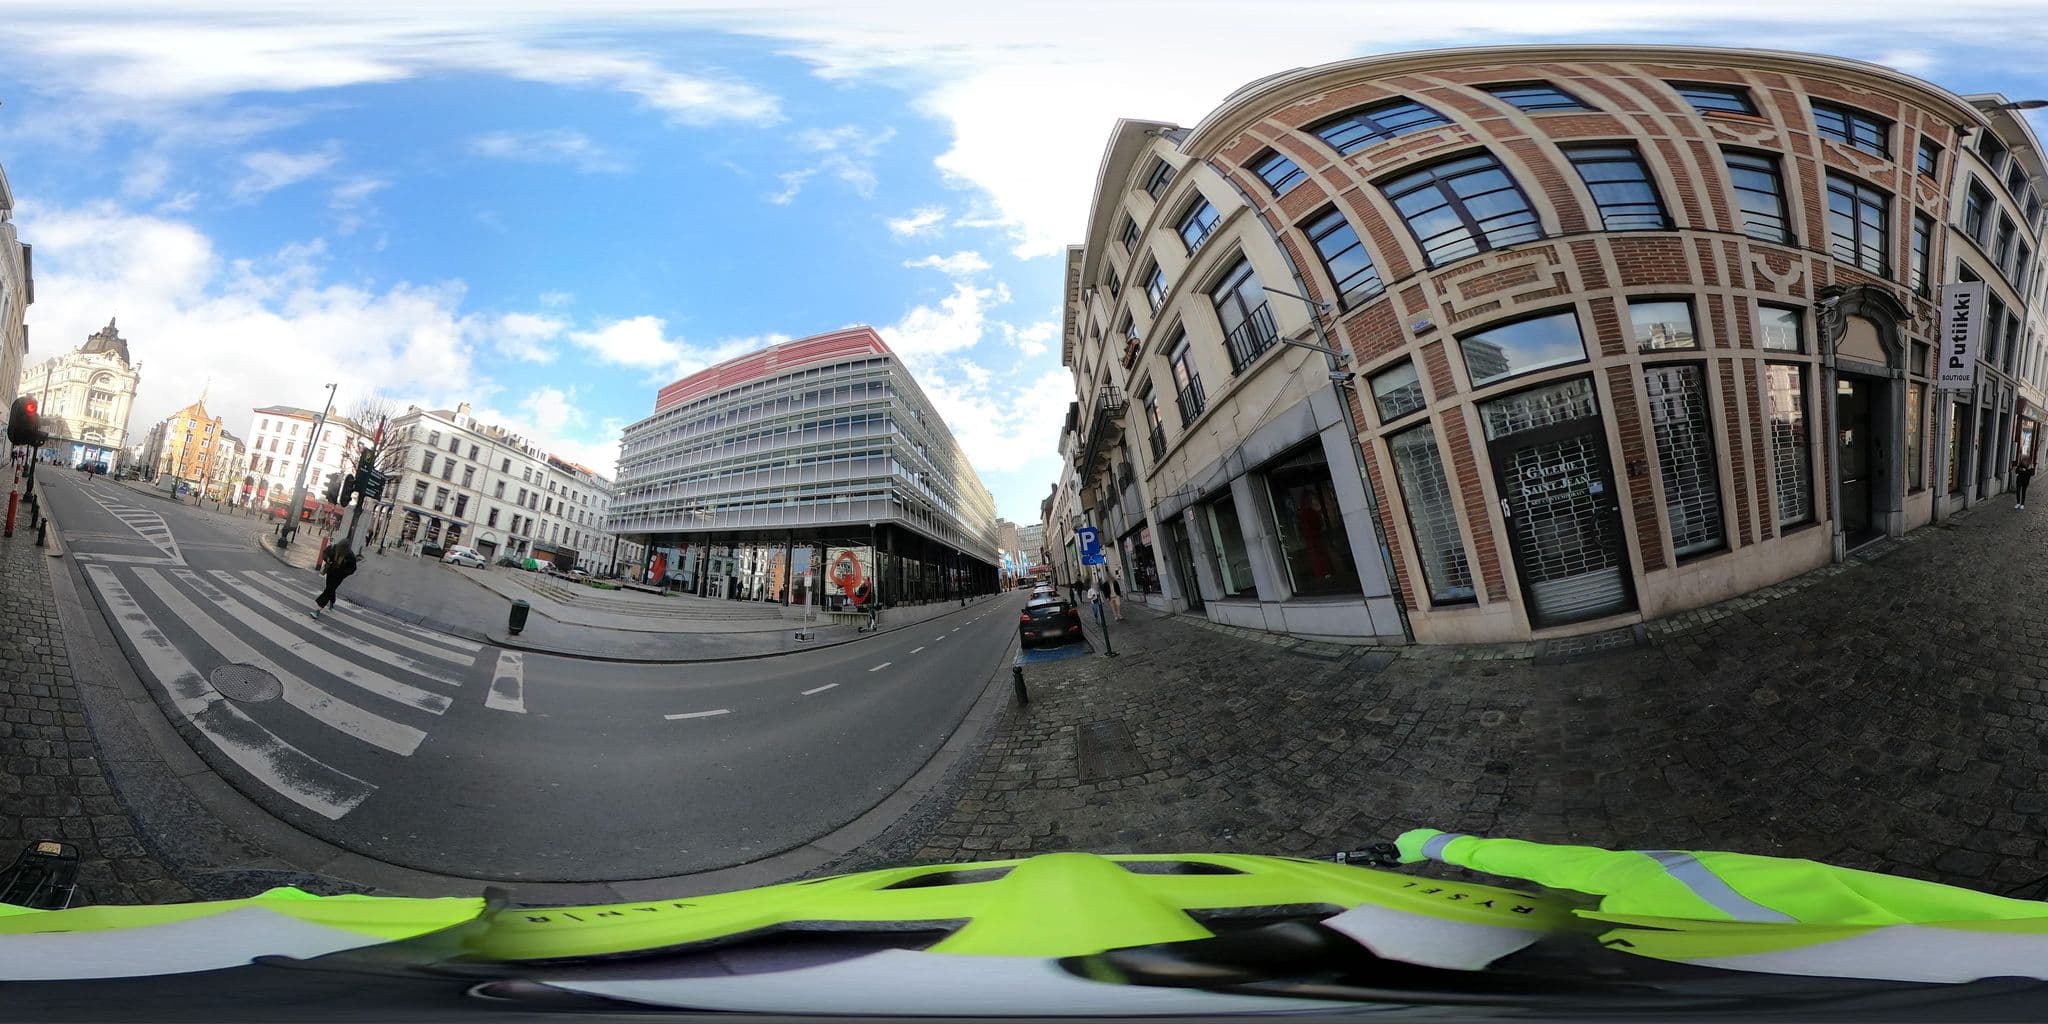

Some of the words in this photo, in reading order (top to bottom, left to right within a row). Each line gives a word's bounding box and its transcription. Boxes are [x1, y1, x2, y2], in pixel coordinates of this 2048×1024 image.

[1949, 293, 1971, 369] Putiikki
[1501, 498, 1511, 518] 15
[1081, 531, 1096, 551] P
